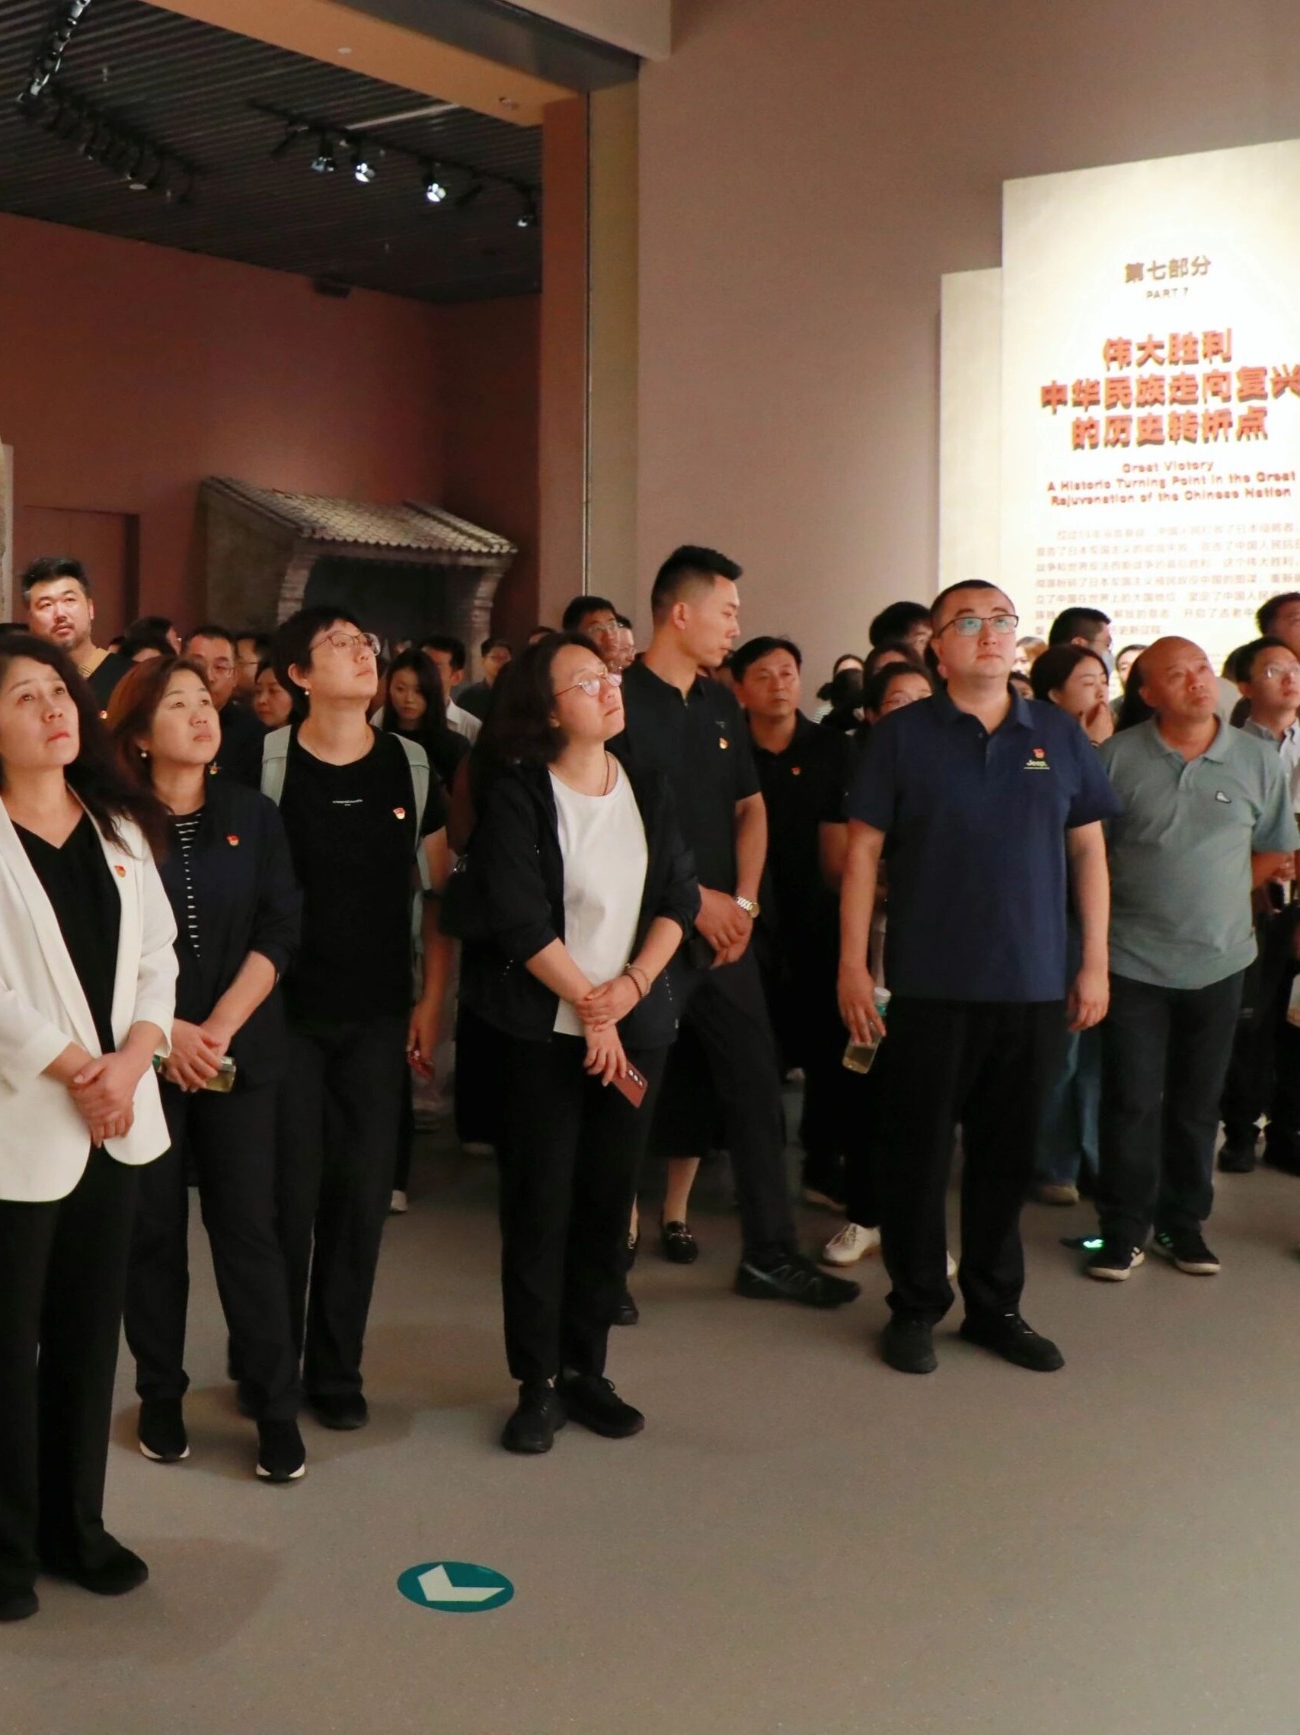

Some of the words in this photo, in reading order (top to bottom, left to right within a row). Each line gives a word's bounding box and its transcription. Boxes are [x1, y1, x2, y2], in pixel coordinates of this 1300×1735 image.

[1125, 255, 1212, 283] 第七部分
[1146, 288, 1178, 299] PART
[1182, 287, 1189, 297] 7
[1102, 328, 1233, 372] 伟大胜利
[1041, 363, 1300, 415] 中华民族走向复兴
[1072, 406, 1268, 450] 的历史转折点
[1123, 462, 1159, 473] Great
[1165, 460, 1214, 472] Victory
[1048, 482, 1055, 492] A
[1061, 479, 1111, 491] Historic
[1117, 477, 1165, 489] Turning
[1172, 475, 1206, 486] Point
[1212, 474, 1223, 484] in
[1229, 473, 1250, 484] the
[1256, 471, 1296, 483] Great
[1051, 493, 1135, 507] Rejuvenation
[1140, 492, 1153, 502] of
[1158, 491, 1179, 502] the
[1184, 488, 1239, 500] Chinese
[1245, 487, 1292, 498] Nation
